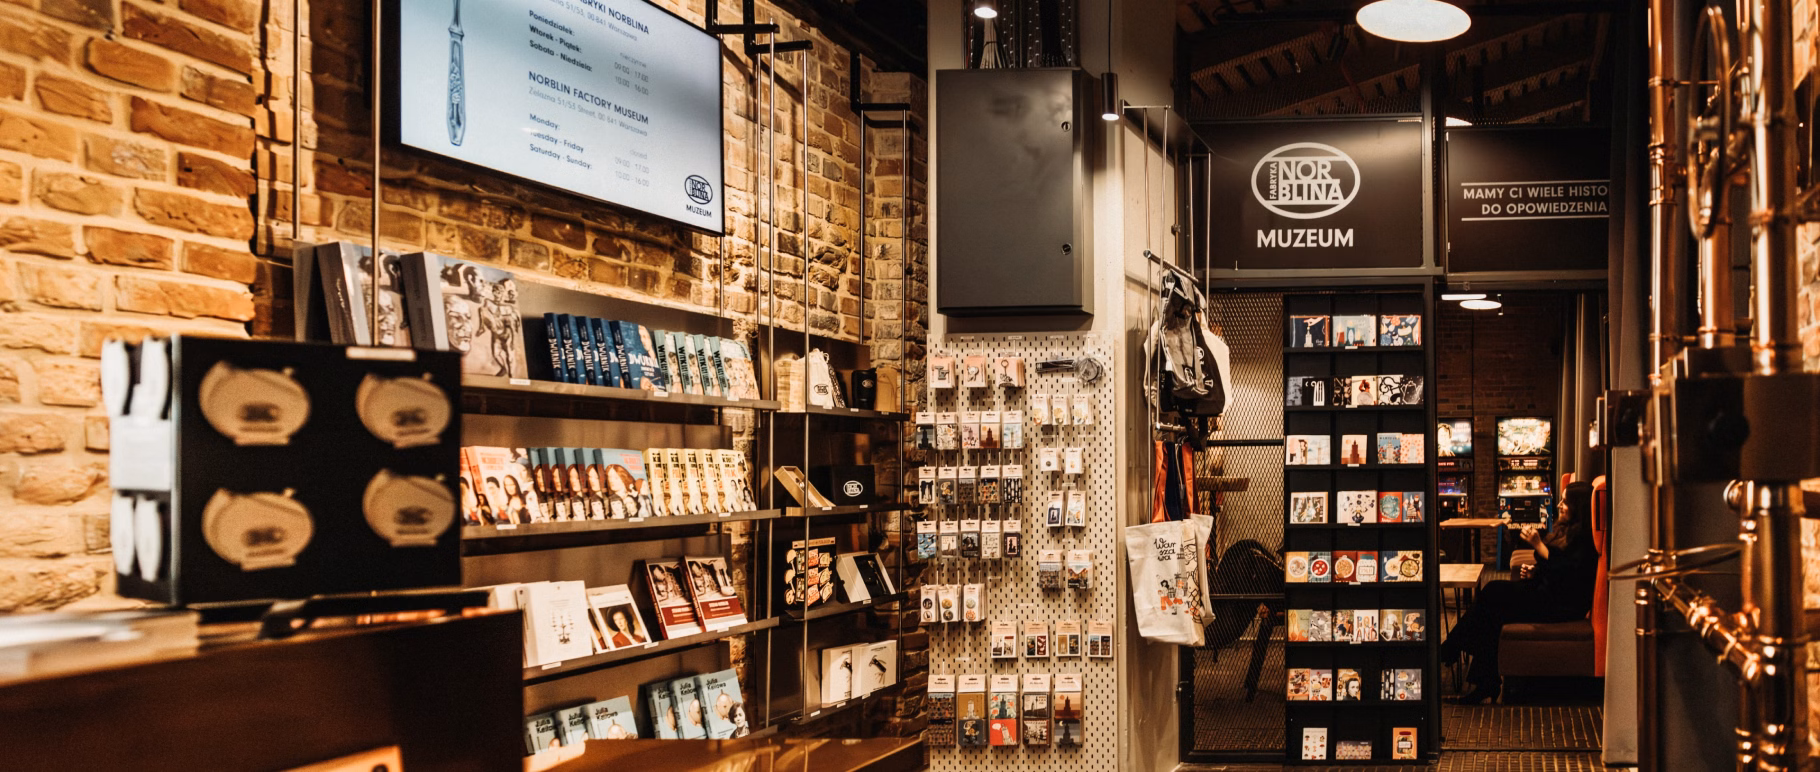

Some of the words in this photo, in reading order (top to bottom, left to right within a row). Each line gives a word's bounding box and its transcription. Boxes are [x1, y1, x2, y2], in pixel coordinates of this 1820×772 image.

[579, 0, 606, 13] BRYKI
[608, 8, 649, 34] NORBLINA
[529, 24, 554, 41] Wtorek
[529, 40, 555, 56] Sobota
[560, 52, 592, 72] Niedziela:
[528, 71, 571, 95] NORBLIN
[573, 88, 612, 110] FACTORY
[614, 104, 649, 125] MUSEUM
[529, 113, 560, 130] Monday:
[563, 139, 584, 154] Friday
[529, 143, 561, 161] Saturday
[566, 155, 592, 170] Sunday:
[1279, 159, 1334, 181] NOR
[1269, 162, 1278, 200] FABRYKA
[1279, 182, 1345, 201] BLINA
[1463, 187, 1505, 199] MAMY
[1509, 187, 1523, 199] CI
[1527, 186, 1564, 198] WIELE
[1569, 185, 1608, 197] HISTO
[686, 204, 712, 218] MUZEUM
[1481, 203, 1502, 215] DO
[1506, 201, 1608, 215] OPOWIEDZENIA
[1257, 228, 1354, 248] MUZEUM
[706, 678, 718, 686] Julia
